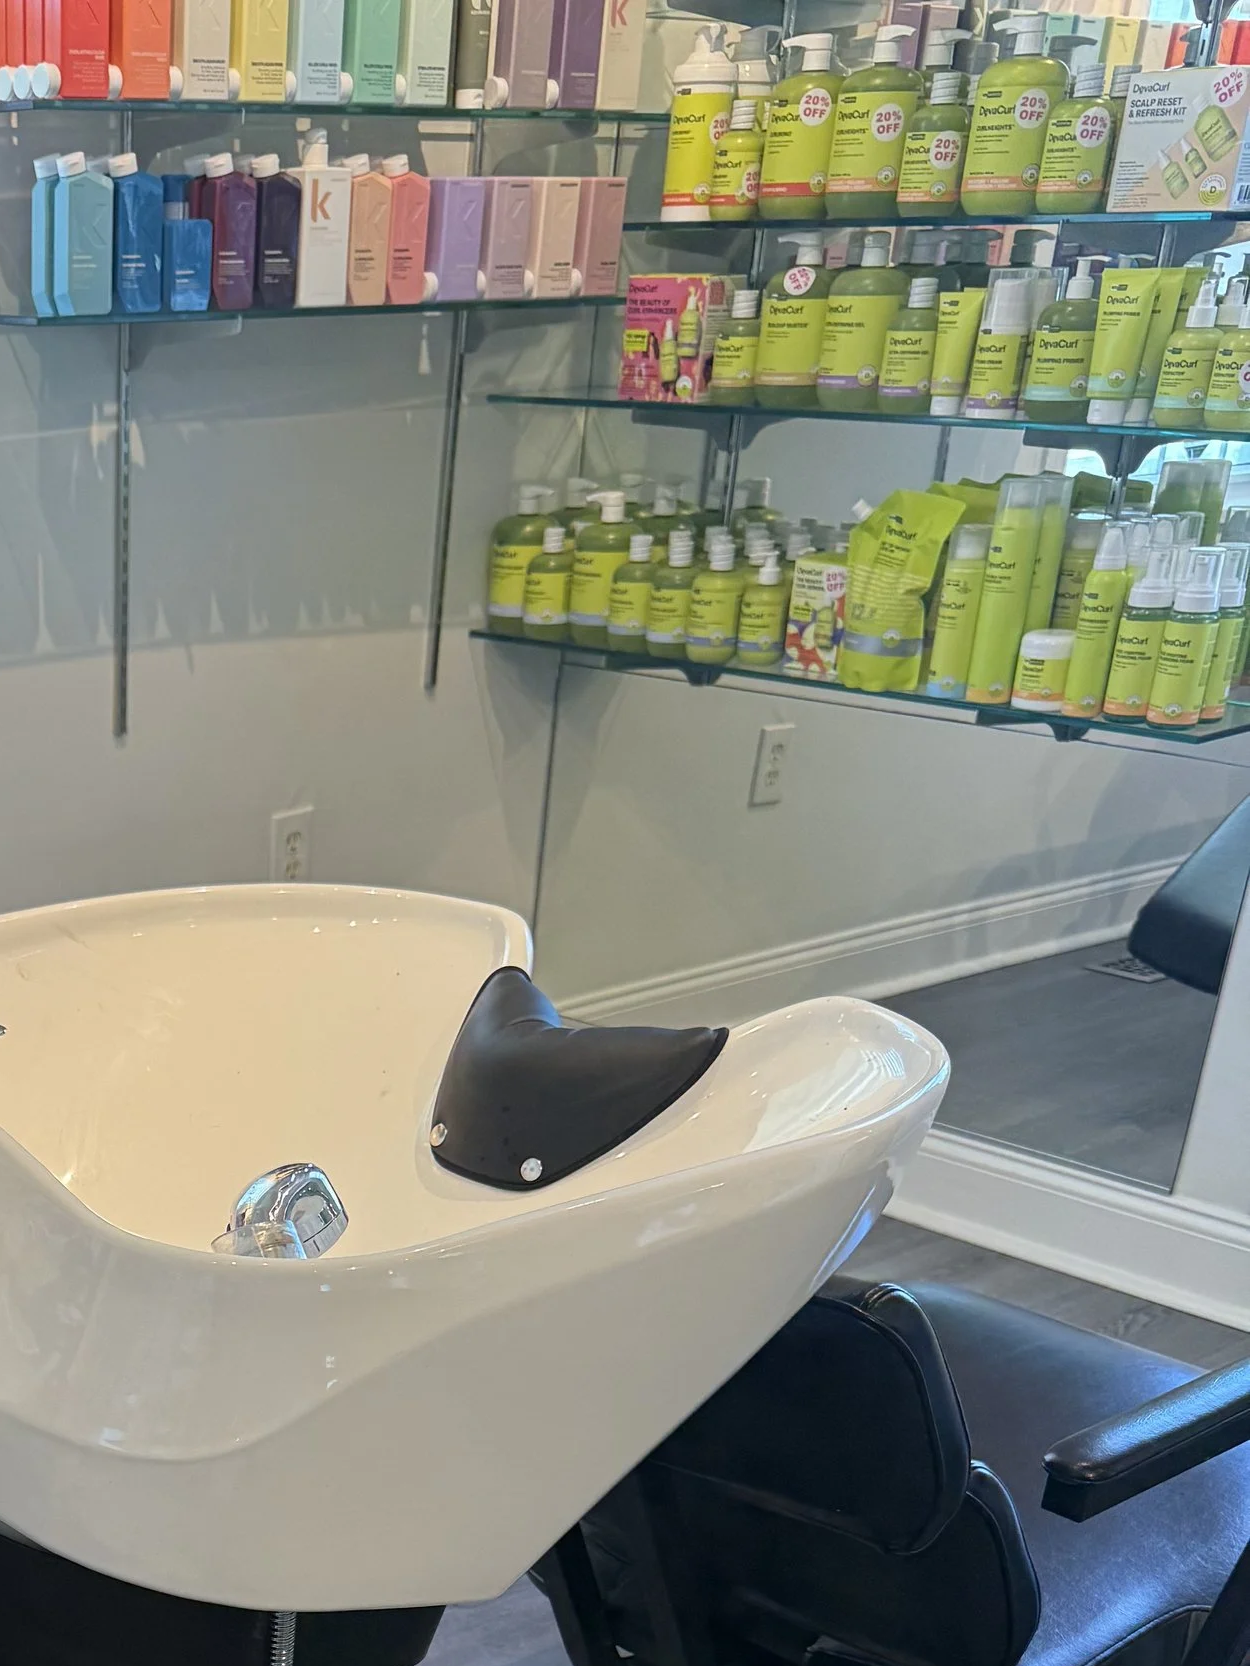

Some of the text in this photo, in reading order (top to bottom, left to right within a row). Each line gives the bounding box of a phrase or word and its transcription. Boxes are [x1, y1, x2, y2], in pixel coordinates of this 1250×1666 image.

[1213, 69, 1243, 93] 20%
[1133, 82, 1170, 94] DevaCurl
[1218, 81, 1243, 103] OFF
[804, 95, 830, 107] 20%
[1020, 96, 1047, 109] 20%
[1130, 97, 1183, 108] SCALP RESET
[771, 112, 802, 124] DevaCur
[803, 107, 826, 118] OFF
[876, 111, 902, 123] 20%
[1019, 110, 1044, 121] OFF
[1128, 107, 1187, 118] & REFRESH KIT
[1081, 115, 1107, 129] 20%
[877, 123, 900, 134] OFF
[1049, 134, 1077, 143] DevaCu
[1080, 129, 1104, 141] OFF
[934, 139, 959, 150] 20%
[905, 146, 930, 155] DevaCu
[934, 151, 957, 162] OFF
[746, 172, 759, 181] 20
[1040, 339, 1079, 350] DevaCurl
